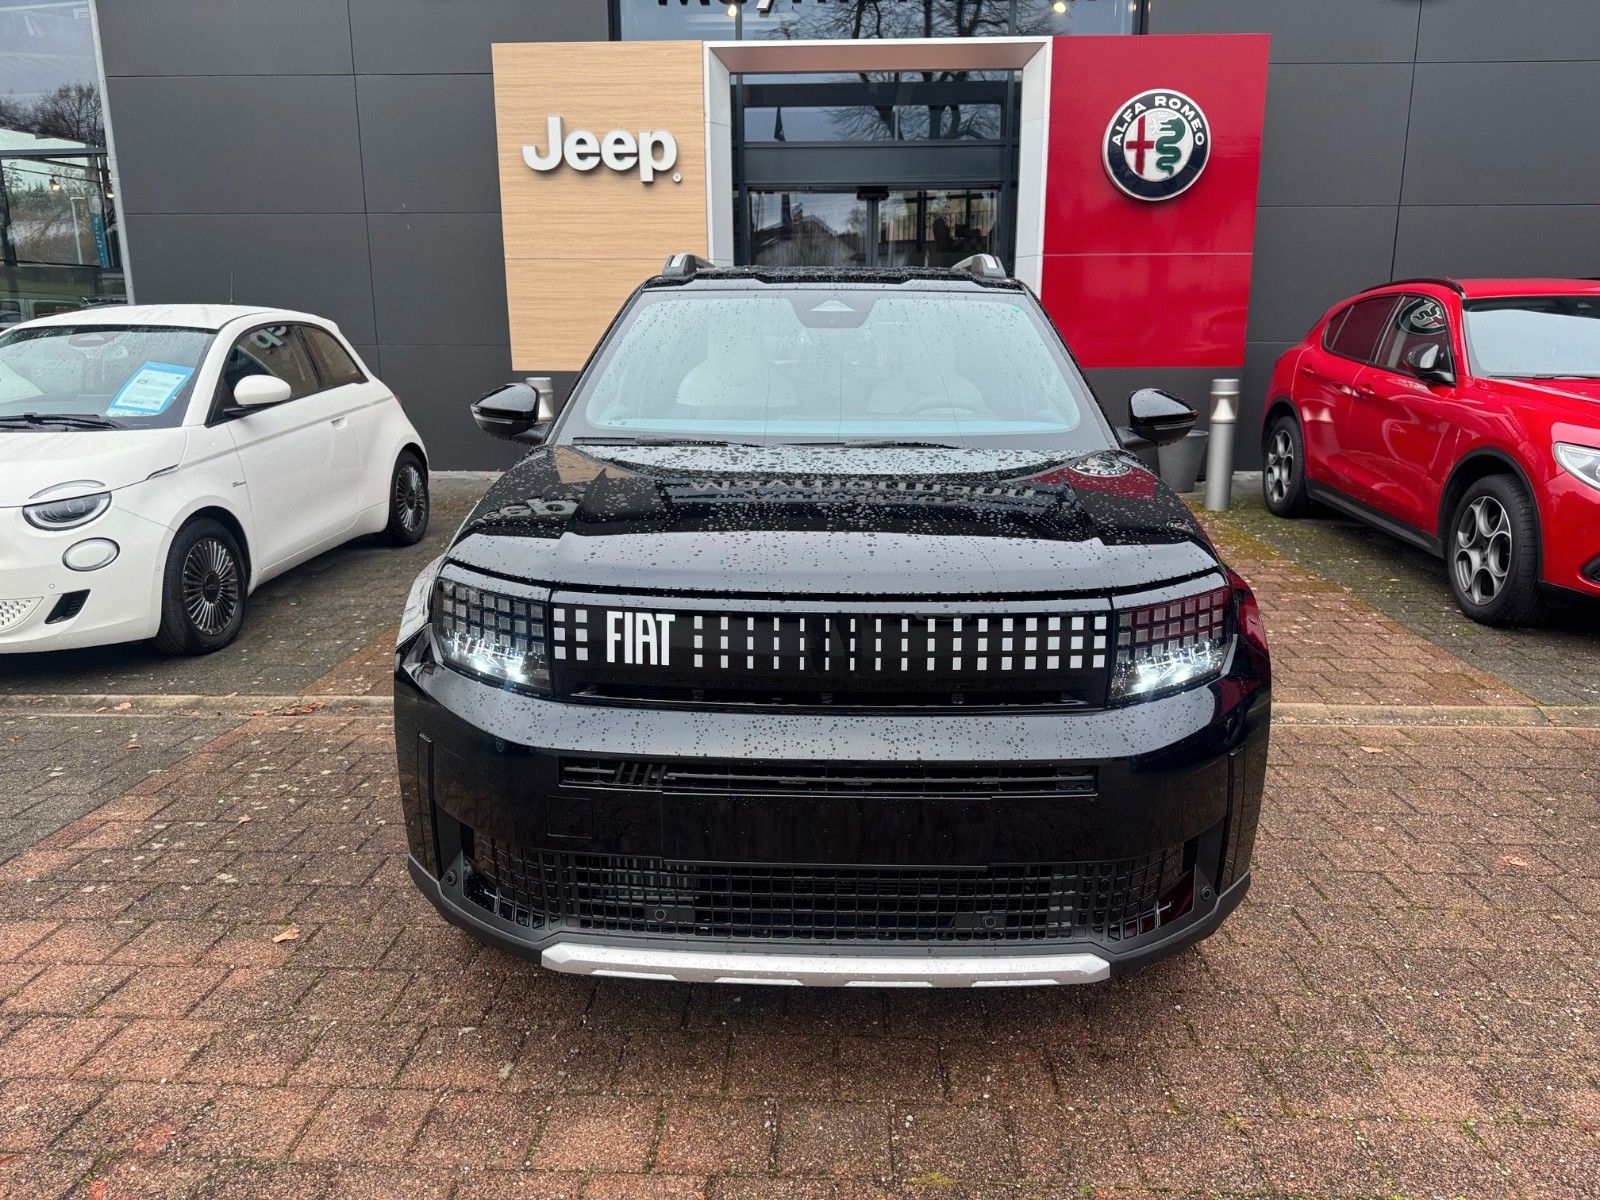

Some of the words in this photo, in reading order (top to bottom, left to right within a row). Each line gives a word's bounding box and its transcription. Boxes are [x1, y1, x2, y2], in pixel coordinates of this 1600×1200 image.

[522, 116, 678, 182] Jeep
[1112, 102, 1147, 146] ALFA
[1154, 96, 1205, 146] ROMEO
[606, 610, 676, 666] FIAT
